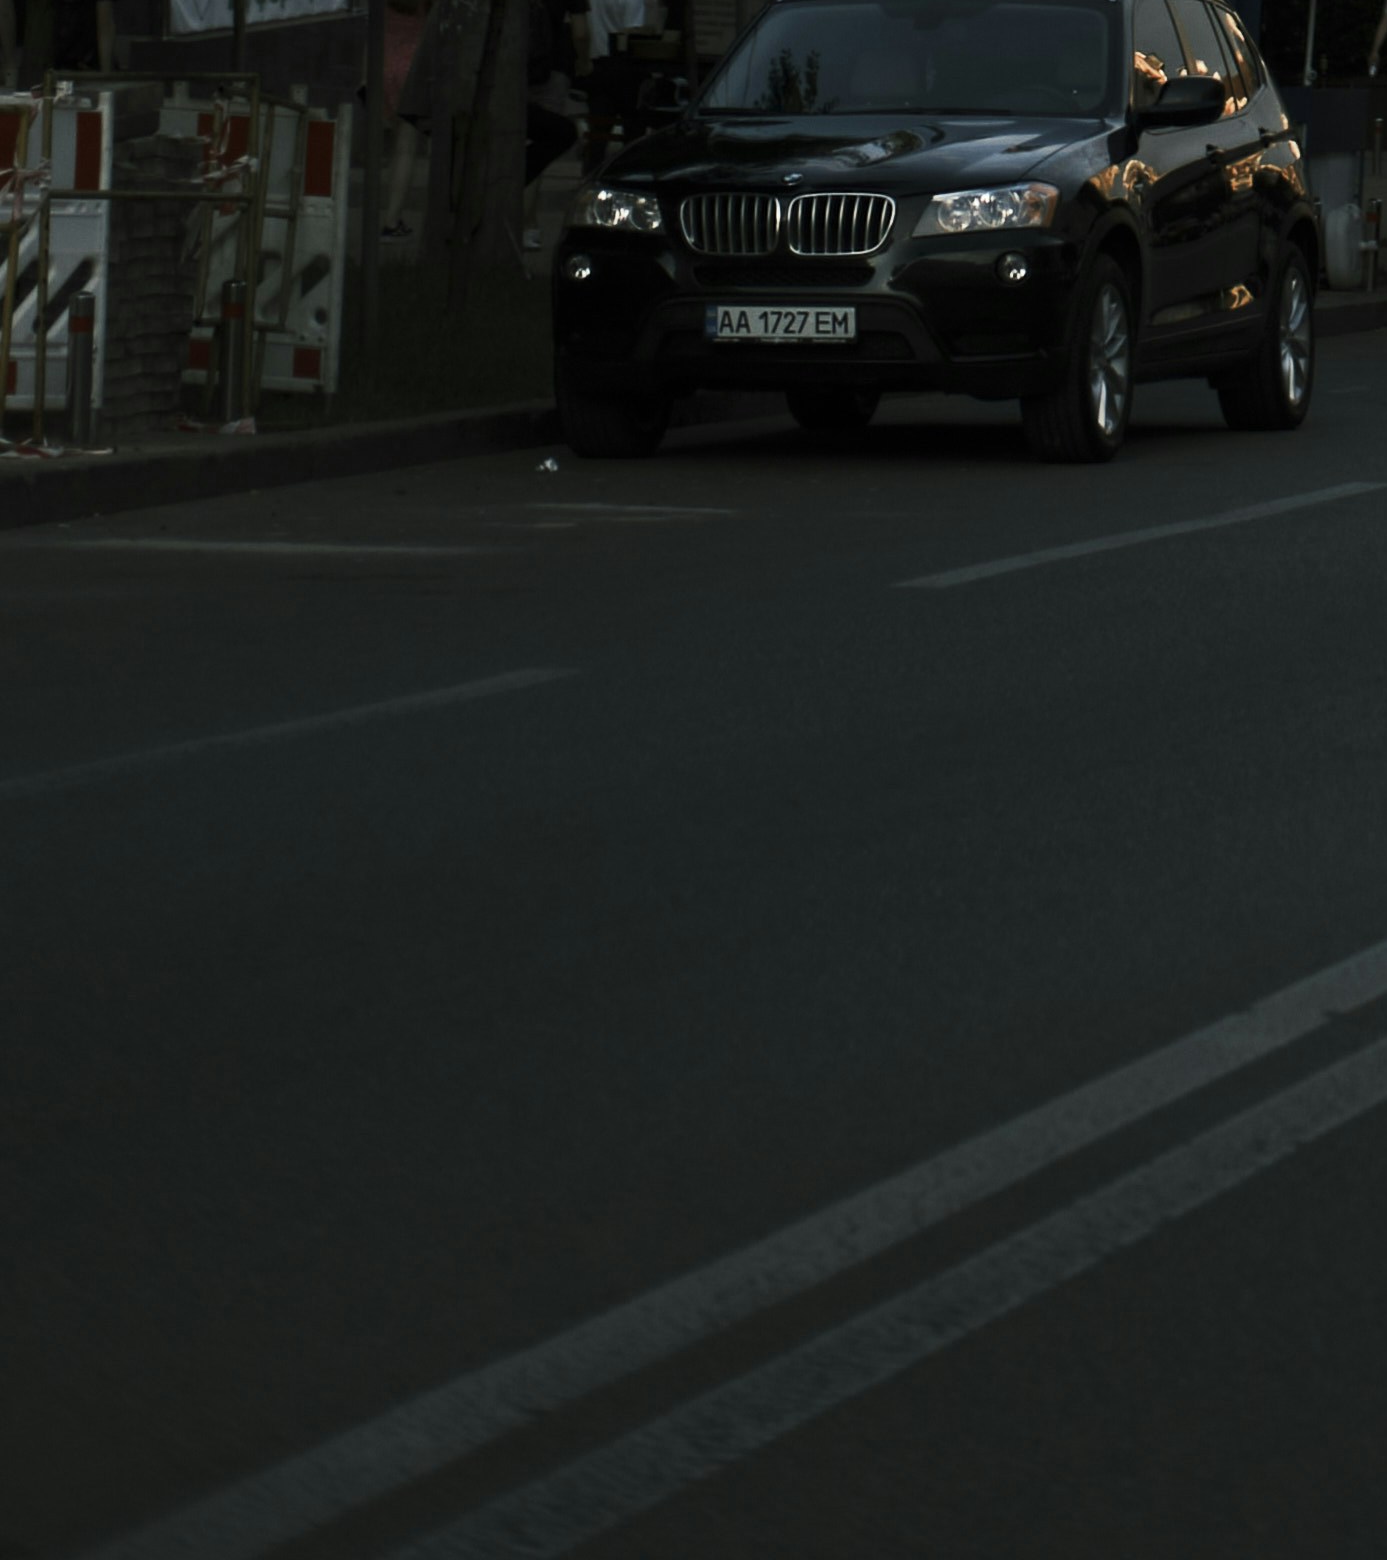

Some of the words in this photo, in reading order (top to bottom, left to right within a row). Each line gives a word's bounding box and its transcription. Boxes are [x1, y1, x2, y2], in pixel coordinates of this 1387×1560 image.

[719, 310, 751, 334] AA
[758, 310, 809, 334] 1727
[815, 311, 849, 335] EM
